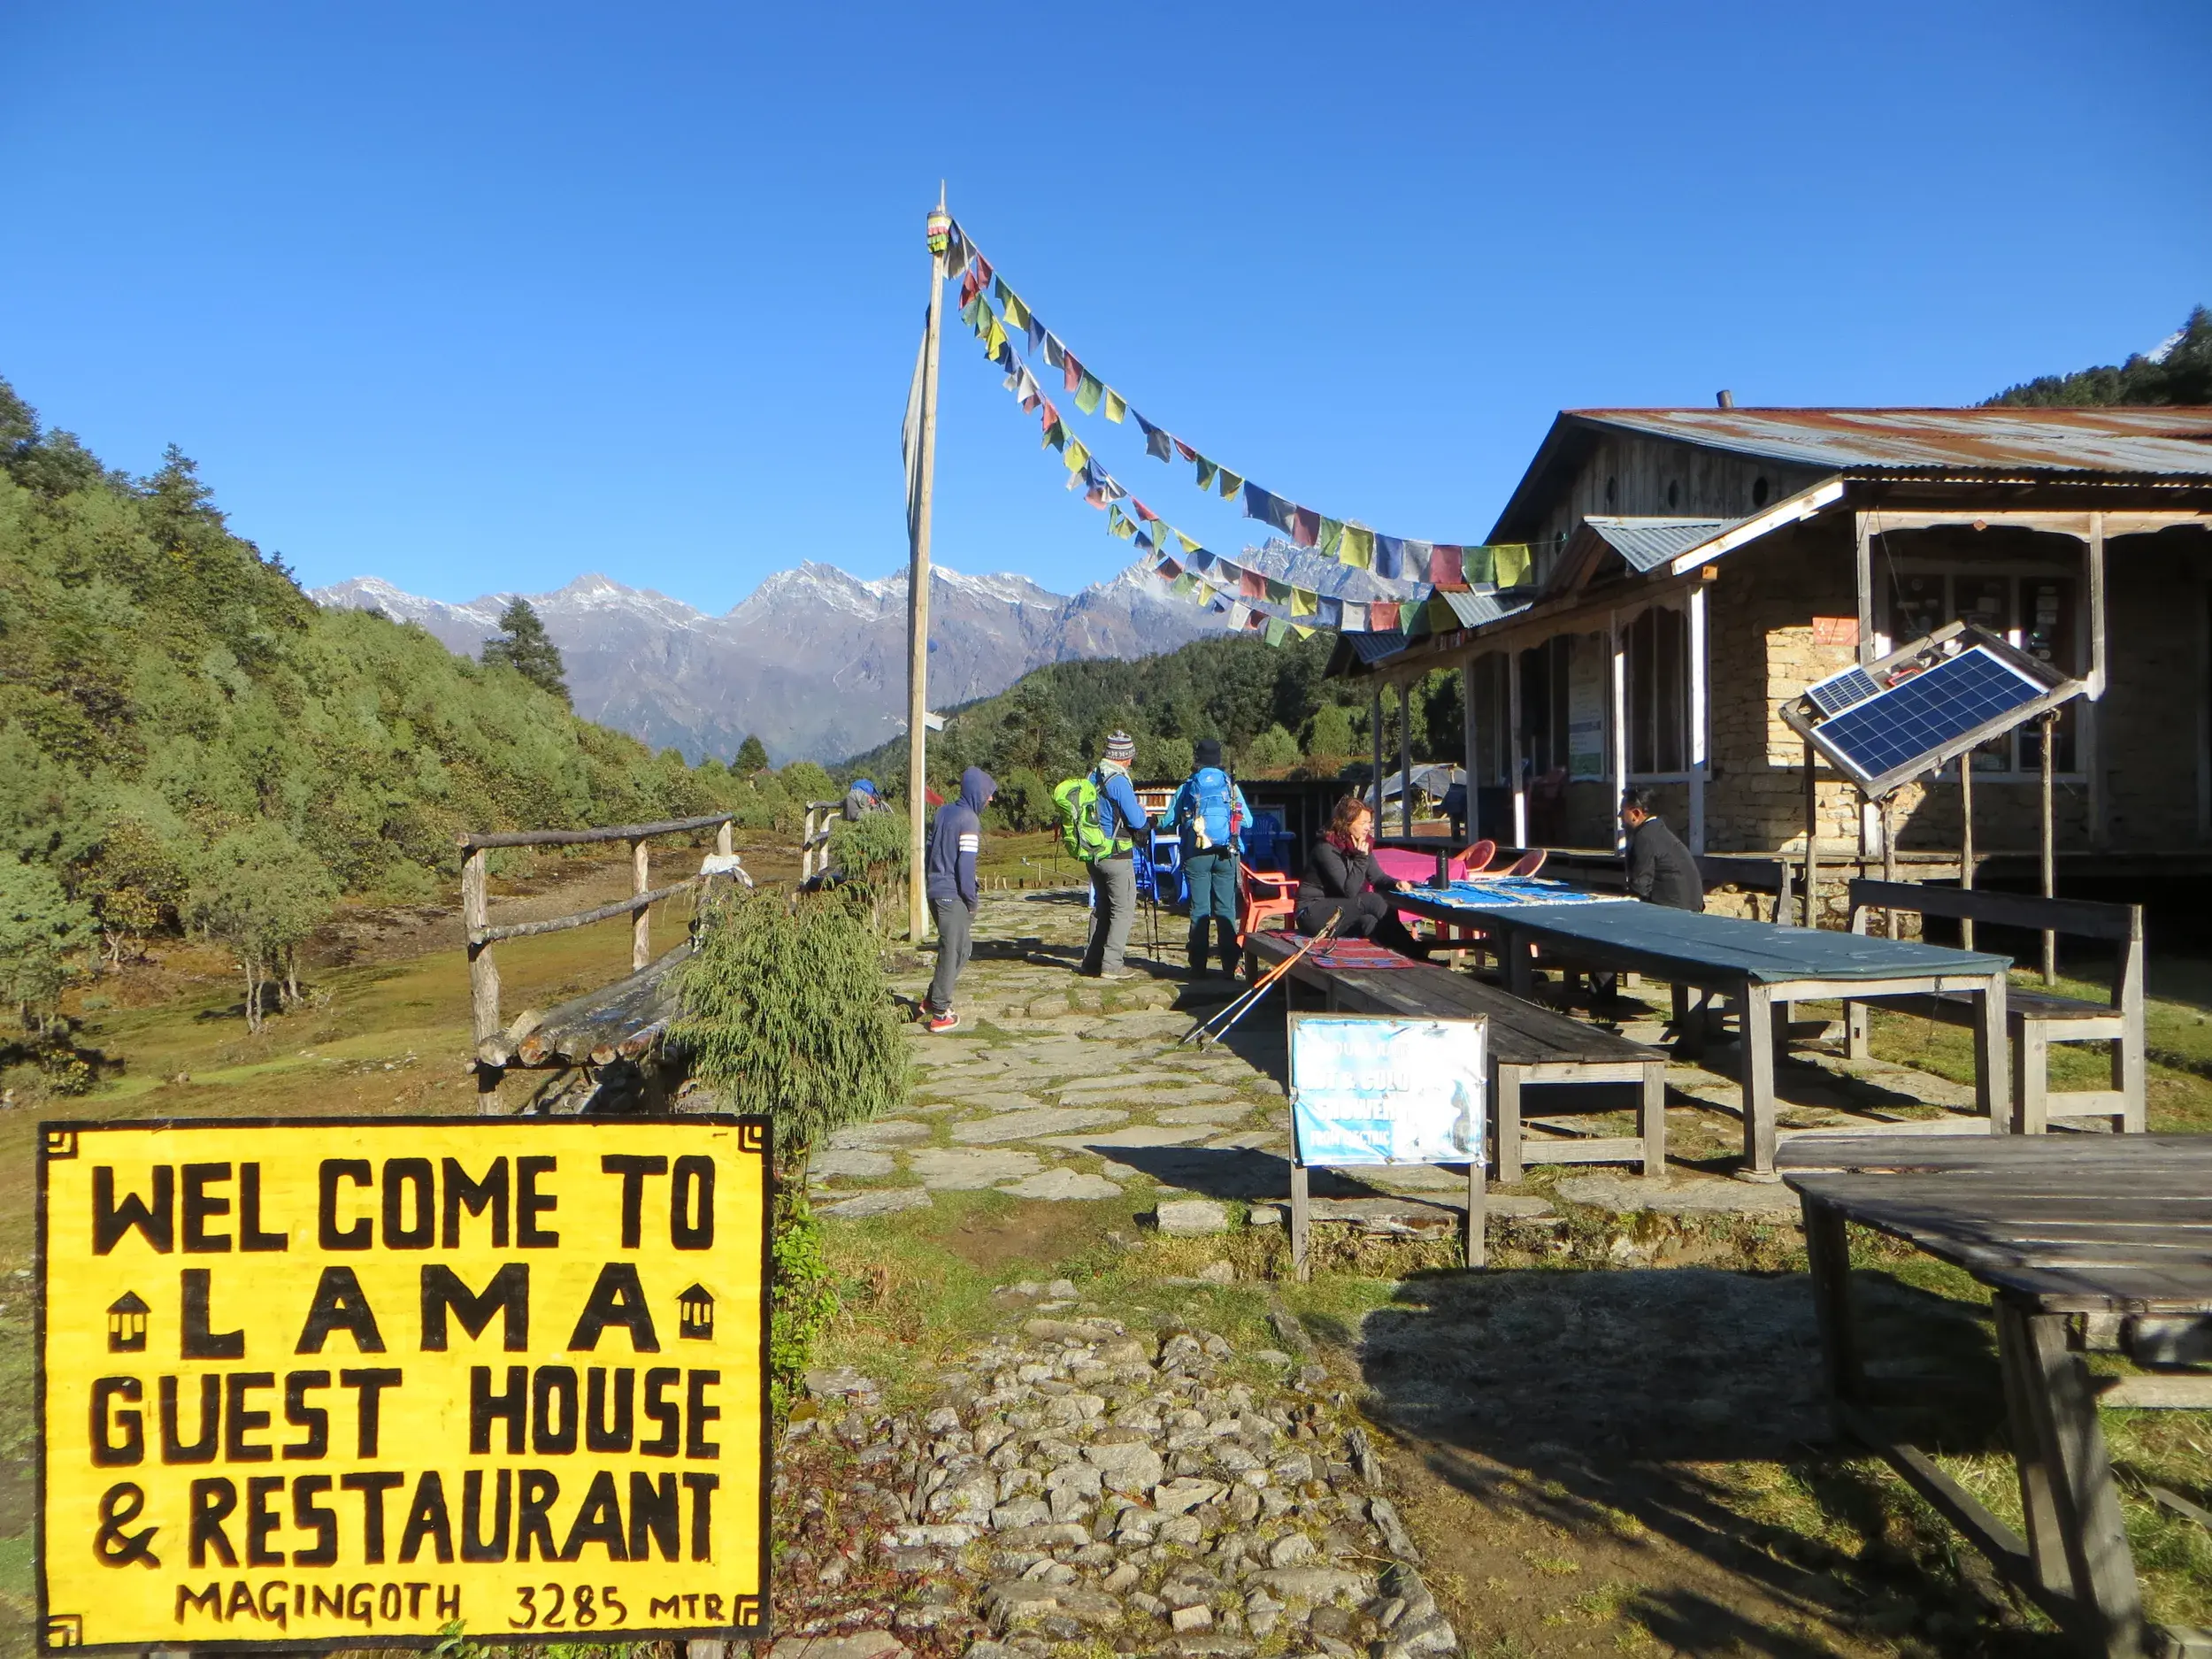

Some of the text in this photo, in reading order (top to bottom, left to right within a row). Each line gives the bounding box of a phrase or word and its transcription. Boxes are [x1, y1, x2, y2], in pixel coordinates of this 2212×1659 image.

[601, 1153, 717, 1251] TO
[180, 1262, 662, 1361] LAMA
[89, 1365, 722, 1467] GUEST HOUSE
[92, 1468, 721, 1569] & RESTAURANT
[173, 1579, 726, 1632] MAGINGOTH 3285 MTR
